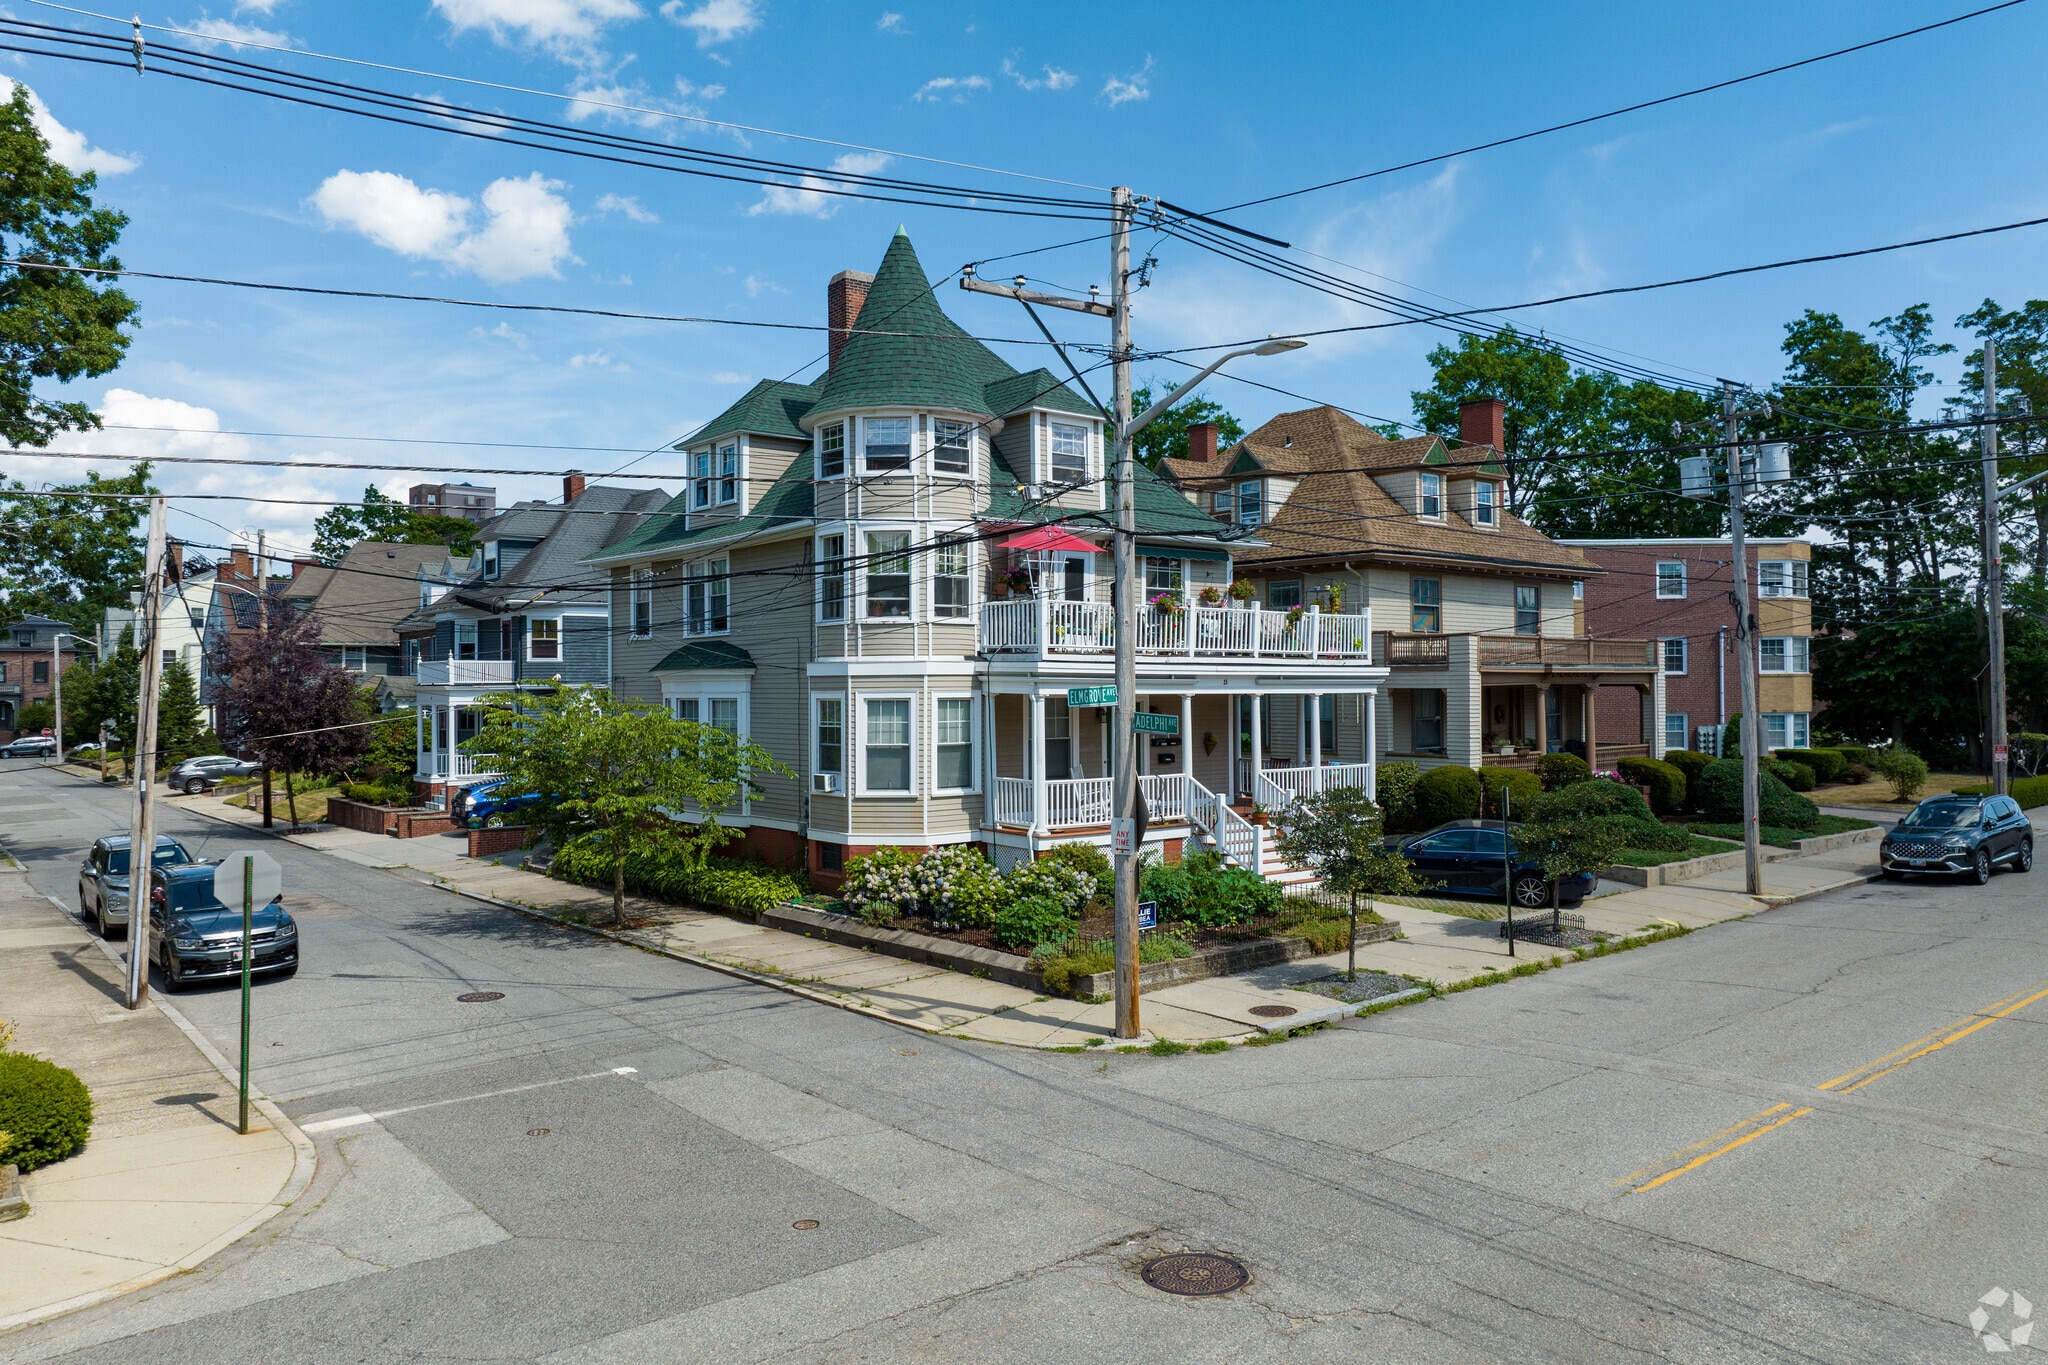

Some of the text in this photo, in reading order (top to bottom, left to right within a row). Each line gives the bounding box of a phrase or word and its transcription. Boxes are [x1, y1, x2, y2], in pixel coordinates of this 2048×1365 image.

[1070, 688, 1115, 704] ELMGROVE AVE
[1135, 715, 1177, 731] ADELPHI AVE
[1116, 830, 1130, 838] ANY
[1115, 838, 1130, 846] TIME
